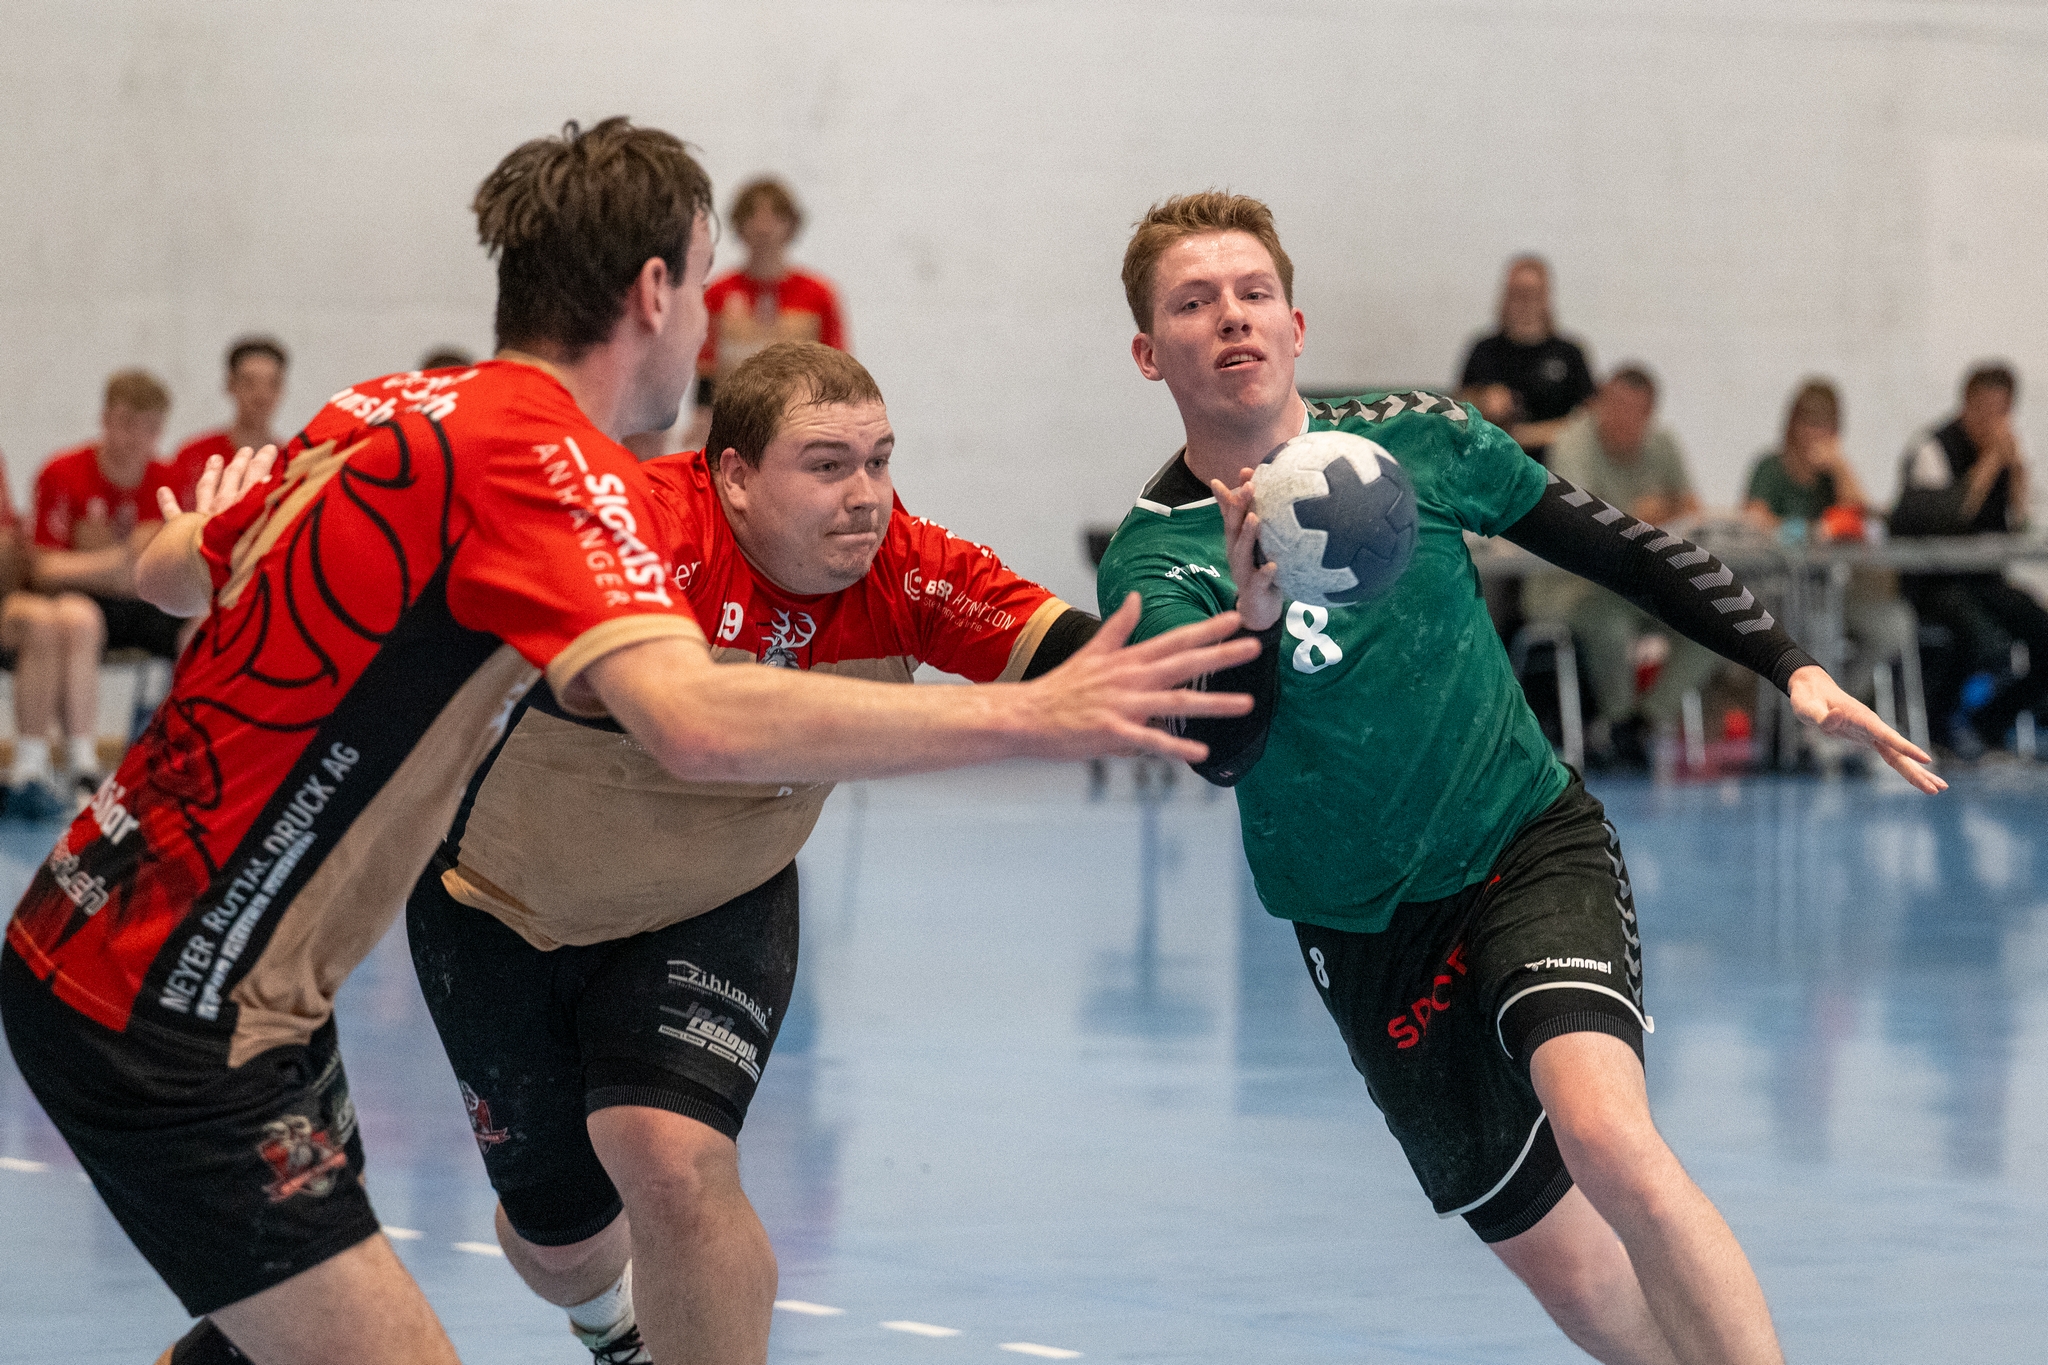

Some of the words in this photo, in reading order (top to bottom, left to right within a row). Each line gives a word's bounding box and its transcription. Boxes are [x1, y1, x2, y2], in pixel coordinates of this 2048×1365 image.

[717, 601, 744, 642] 19
[1286, 600, 1343, 675] 8
[320, 741, 360, 782] AG
[1308, 946, 1331, 989] 8
[1545, 956, 1612, 975] hummel
